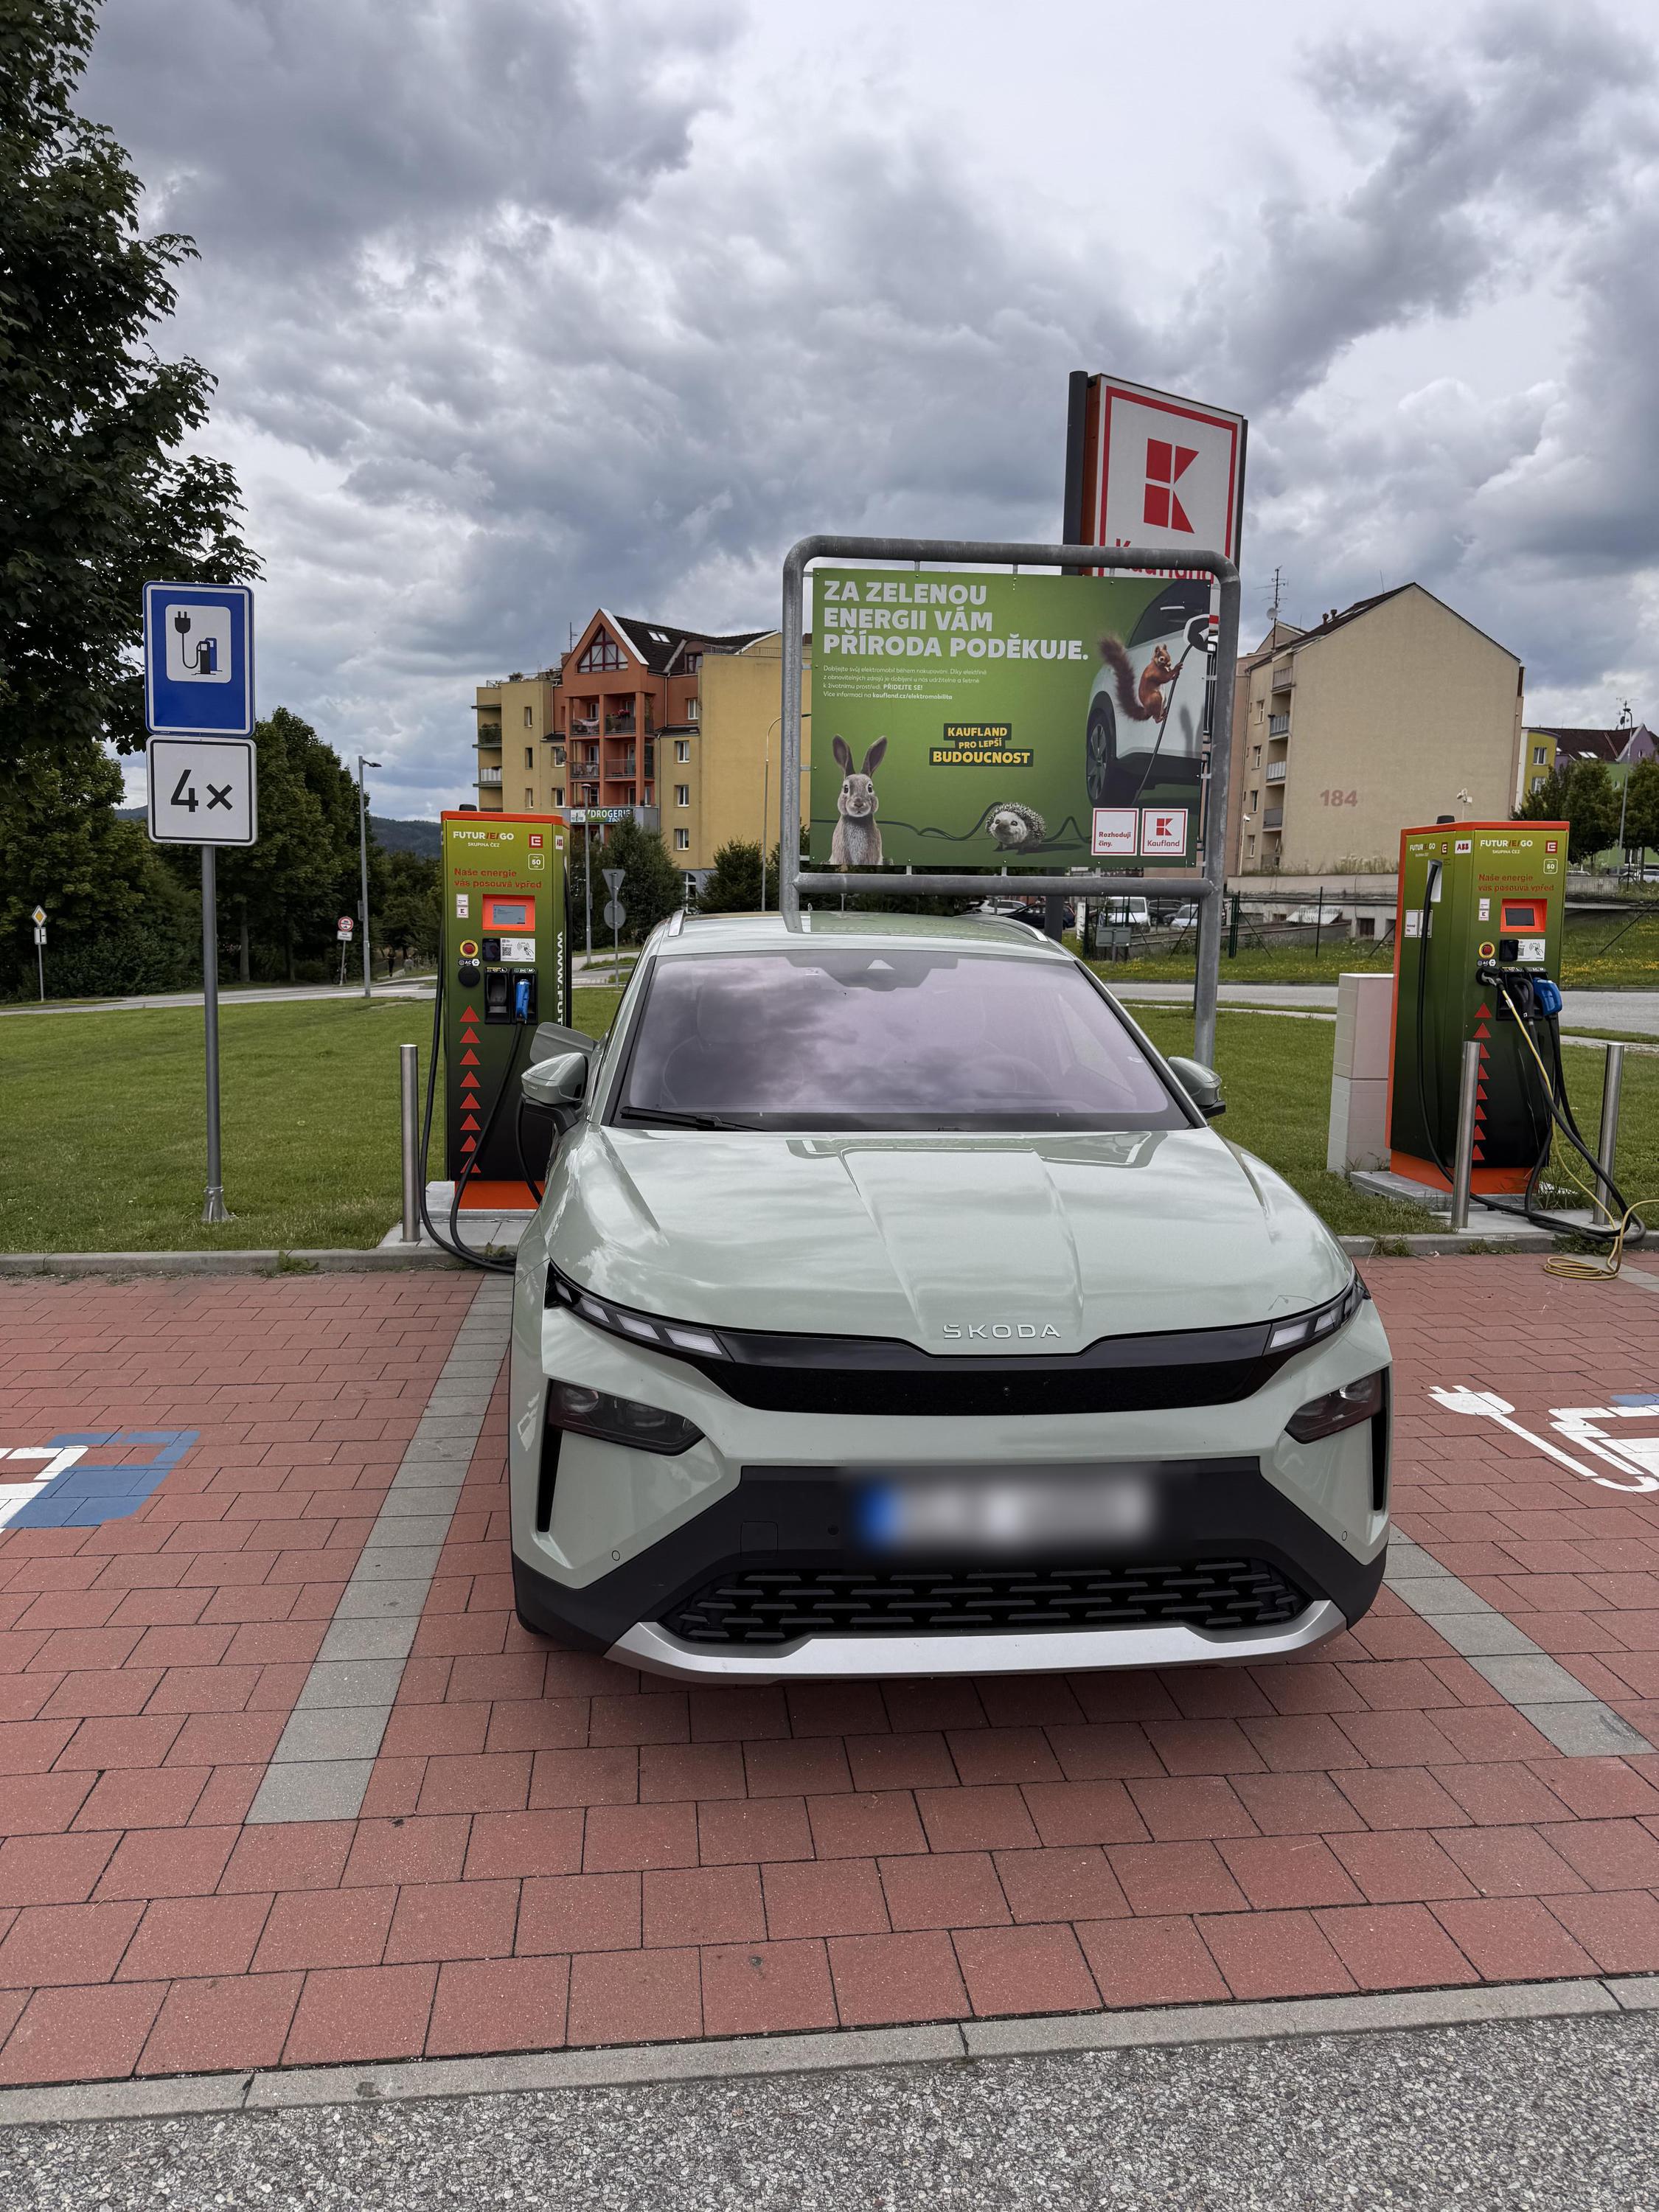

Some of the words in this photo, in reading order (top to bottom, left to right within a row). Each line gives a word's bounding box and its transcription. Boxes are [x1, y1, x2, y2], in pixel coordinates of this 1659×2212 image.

[824, 580, 860, 602] ZA
[866, 582, 987, 605] ZELENOU
[824, 607, 927, 630] ENERGII
[934, 606, 992, 632] VÁM
[823, 629, 942, 657] PŘÍRODA
[950, 633, 1089, 661] PODĚKUJE.
[947, 727, 1008, 737] KAUFLAND
[959, 741, 977, 749] PRO
[978, 737, 1002, 748] LEPŠÍ
[933, 751, 1031, 764] BUDOUCNOST
[1320, 789, 1358, 807] 184
[1099, 831, 1131, 839] Rozhodují
[1457, 843, 1469, 851] ABB
[454, 868, 479, 876] Naše
[481, 869, 517, 878] energie
[1478, 873, 1500, 881] Naše
[1501, 874, 1534, 883] energie
